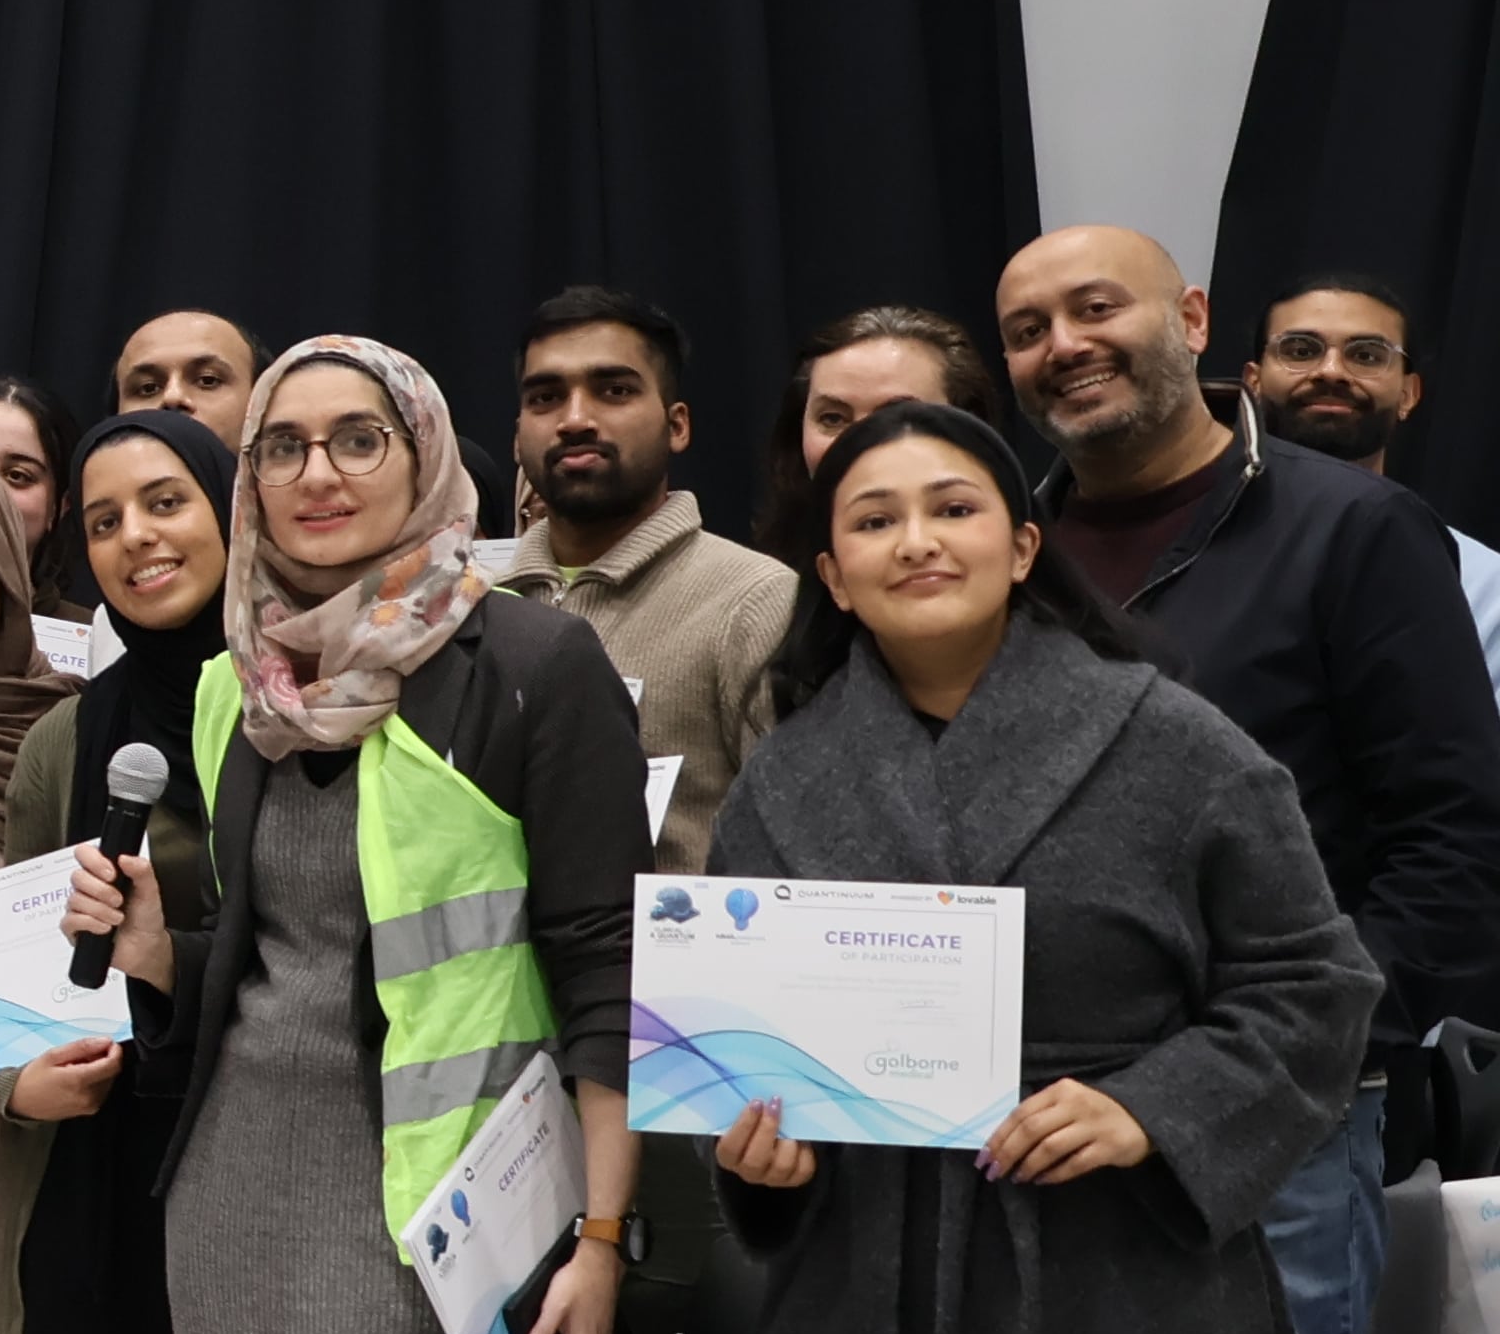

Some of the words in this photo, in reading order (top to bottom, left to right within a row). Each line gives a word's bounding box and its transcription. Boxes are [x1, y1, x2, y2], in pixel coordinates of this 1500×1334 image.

[957, 894, 996, 905] lovable
[825, 930, 961, 950] CERTIFICATE
[840, 951, 858, 961] OF
[862, 952, 962, 965] PARTICIPATION
[864, 1050, 960, 1076] golborne
[498, 1120, 551, 1193] CERTIFICATE
